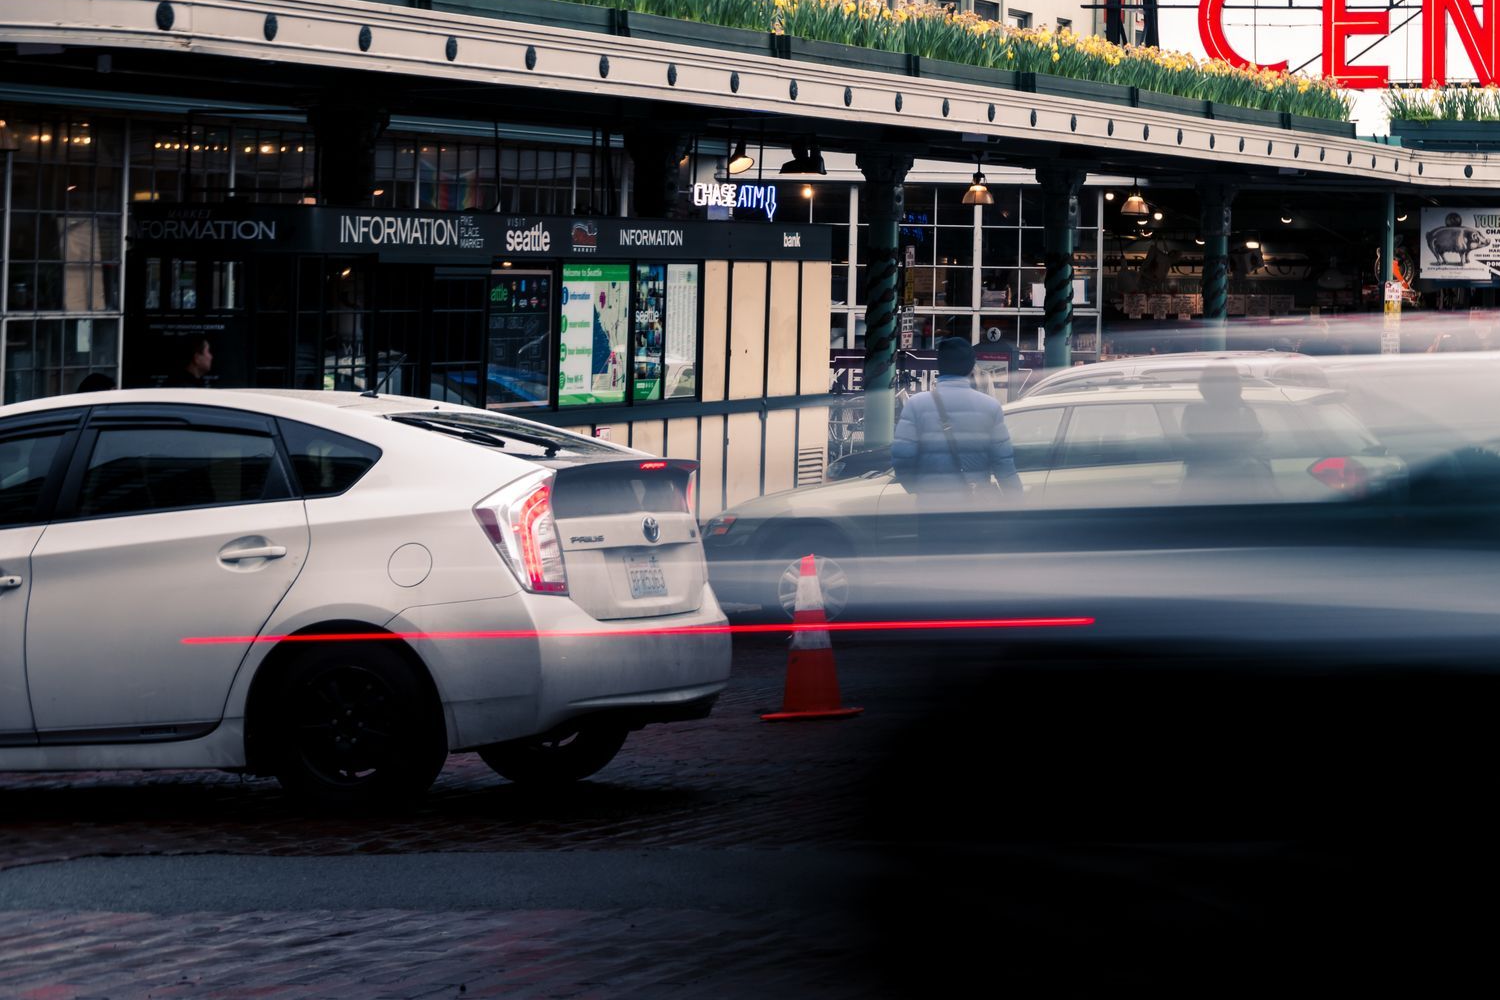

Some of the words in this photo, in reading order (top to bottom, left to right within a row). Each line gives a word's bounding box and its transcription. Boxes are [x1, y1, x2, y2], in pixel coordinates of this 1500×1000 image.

[694, 183, 737, 207] CHASE
[737, 185, 764, 209] ATM
[128, 220, 277, 240] NFORMATION
[340, 216, 459, 246] INFORMATION
[506, 218, 526, 226] VISIT
[460, 238, 484, 249] MARKET
[506, 221, 551, 251] seattle
[619, 229, 684, 246] INFORMATION
[783, 232, 801, 247] bank
[635, 305, 659, 322] seattle
[828, 368, 864, 391] KE
